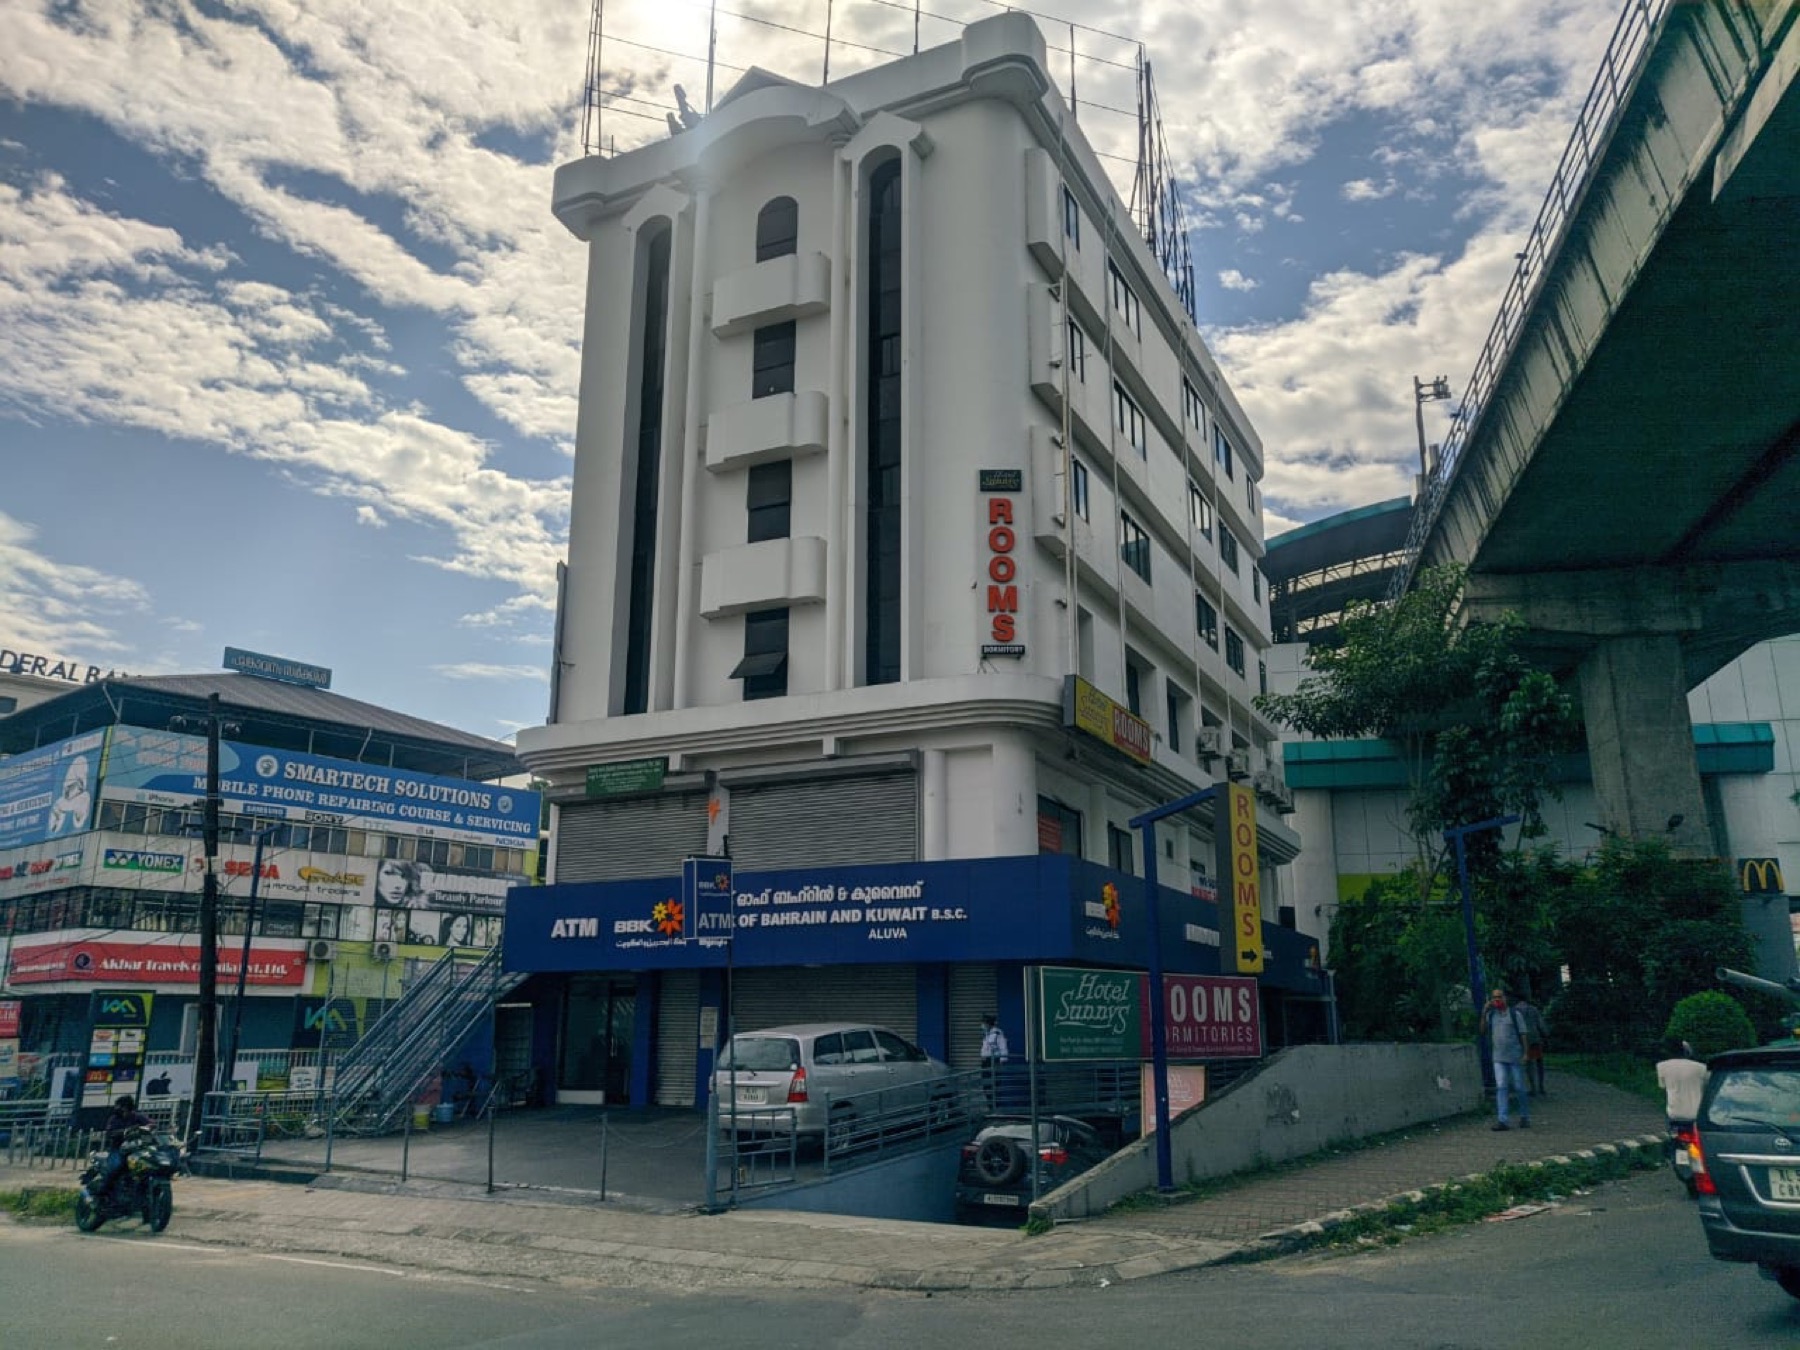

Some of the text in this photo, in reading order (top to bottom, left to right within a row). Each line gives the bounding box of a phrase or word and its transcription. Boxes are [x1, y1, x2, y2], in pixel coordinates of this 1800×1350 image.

[988, 498, 1018, 643] ROOMS
[1114, 708, 1149, 752] ROOMS
[284, 761, 492, 810] SMARTECH SOLUTIONS
[193, 775, 531, 834] MBILE PHONE REPAIRING COURSE & SERVICING
[245, 804, 284, 816] SAMSUNG
[305, 810, 344, 824] SONY
[137, 853, 181, 869] YONEX
[1236, 795, 1258, 937] ROOMS
[551, 917, 598, 939] ATM
[614, 919, 655, 934] BBK
[698, 912, 731, 929] ATM
[738, 906, 968, 928] OF BAHRAIN AND KUWAIT B.S.C.
[868, 926, 908, 940] ALUVA
[100, 957, 141, 971] Akbar
[1076, 972, 1132, 1003] Hotel
[1170, 985, 1251, 1023] OOMS
[1166, 1026, 1253, 1043] RMITORIES
